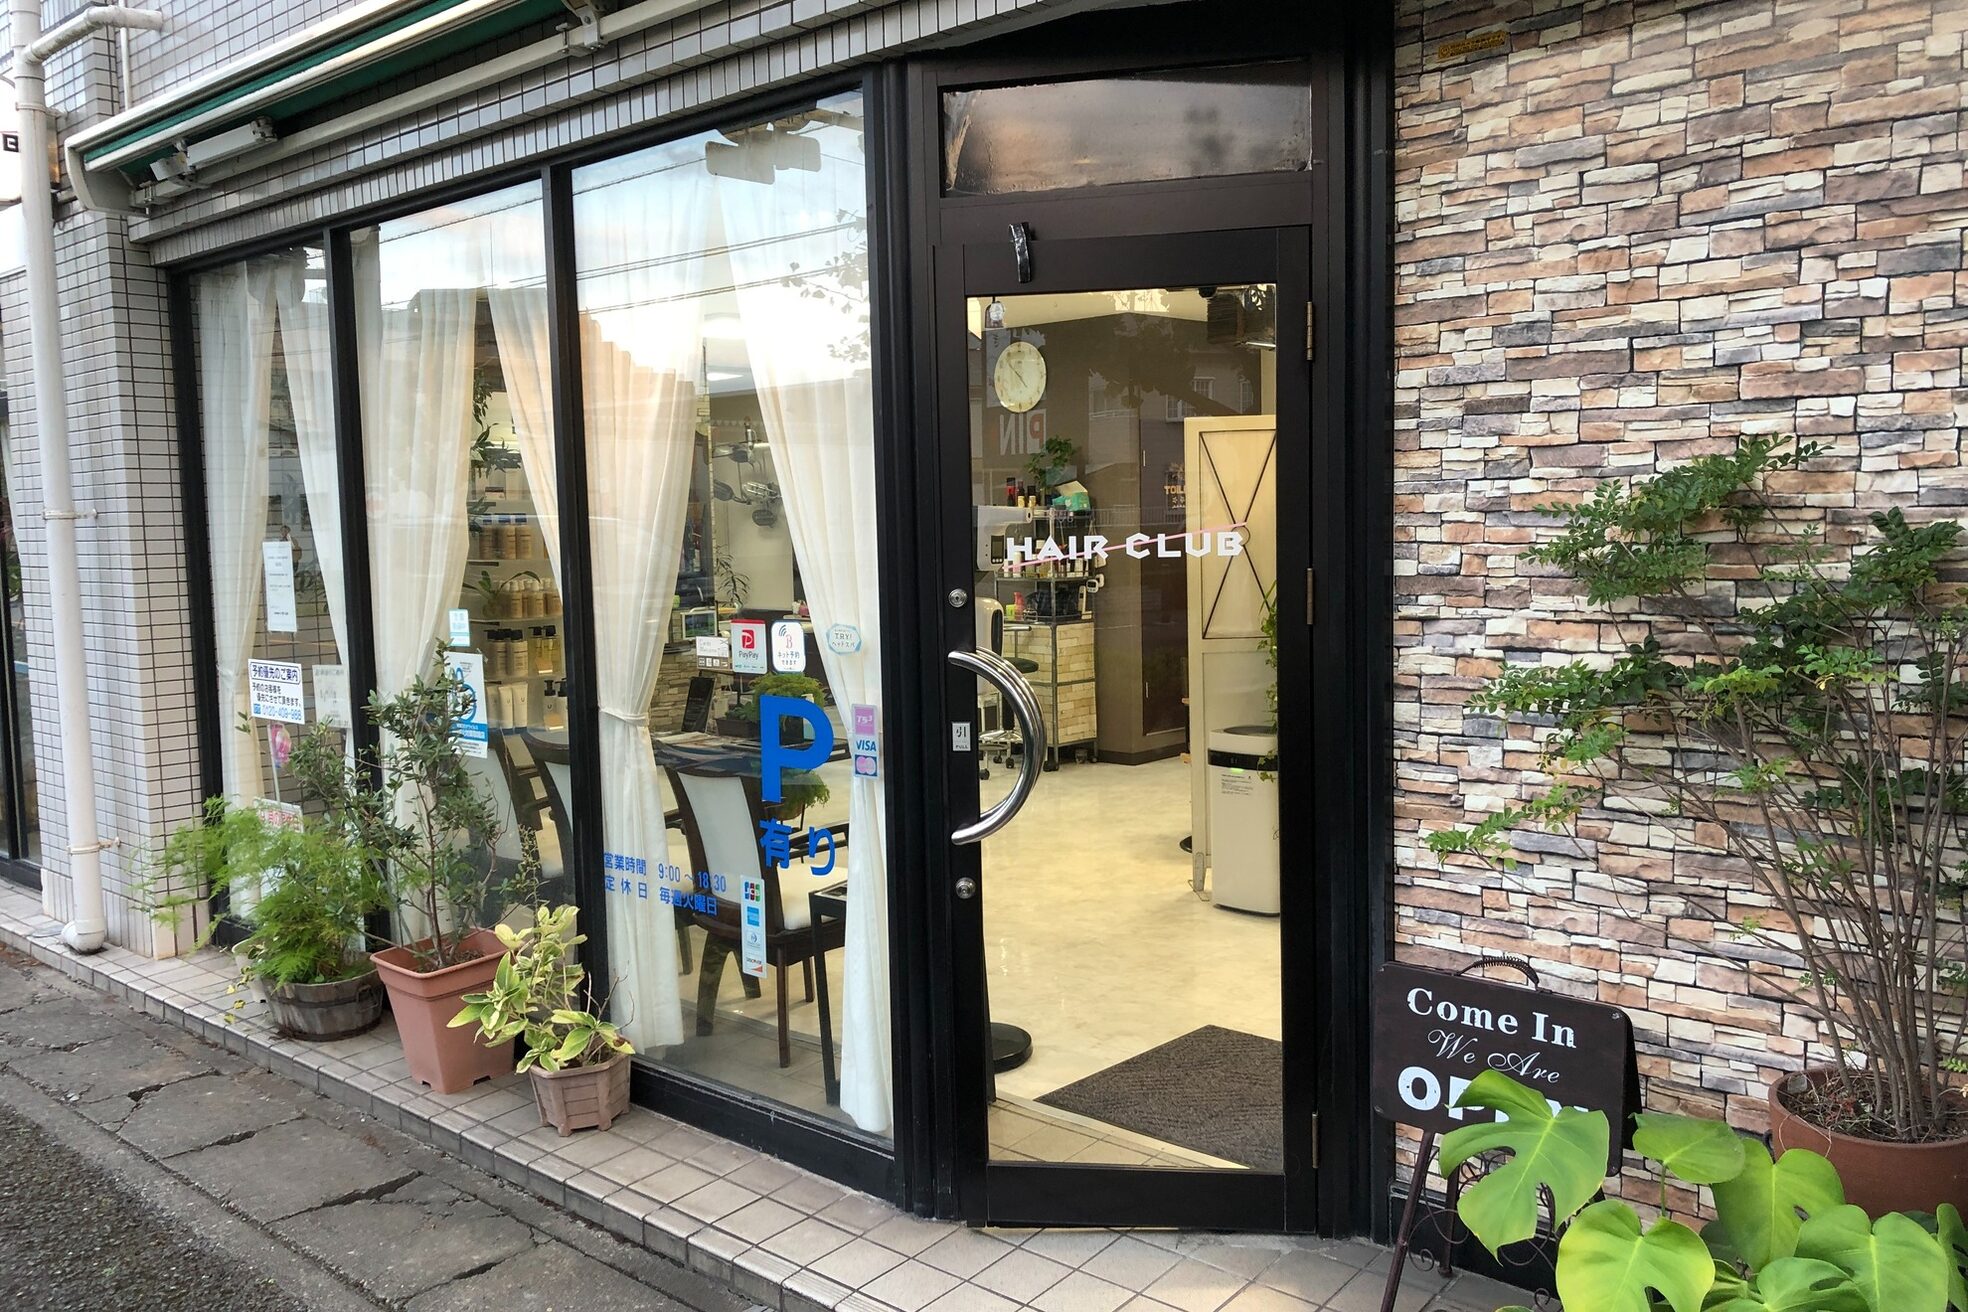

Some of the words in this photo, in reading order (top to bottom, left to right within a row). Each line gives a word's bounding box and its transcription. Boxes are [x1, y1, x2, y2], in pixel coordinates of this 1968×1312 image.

[1006, 535, 1108, 561] HAIR
[1126, 532, 1243, 559] CLUB
[738, 650, 759, 660] PayPay
[760, 694, 835, 803] P
[856, 740, 877, 752] VISA
[604, 852, 647, 876] 営業時間
[658, 863, 681, 883] 9:00
[759, 817, 835, 875] 有り
[659, 886, 718, 917] 毎週火曜日
[1407, 987, 1519, 1035] Come
[1532, 1012, 1577, 1049] In
[1427, 1029, 1478, 1064] We
[1487, 1052, 1561, 1084] Are
[1397, 1066, 1590, 1124] OP
